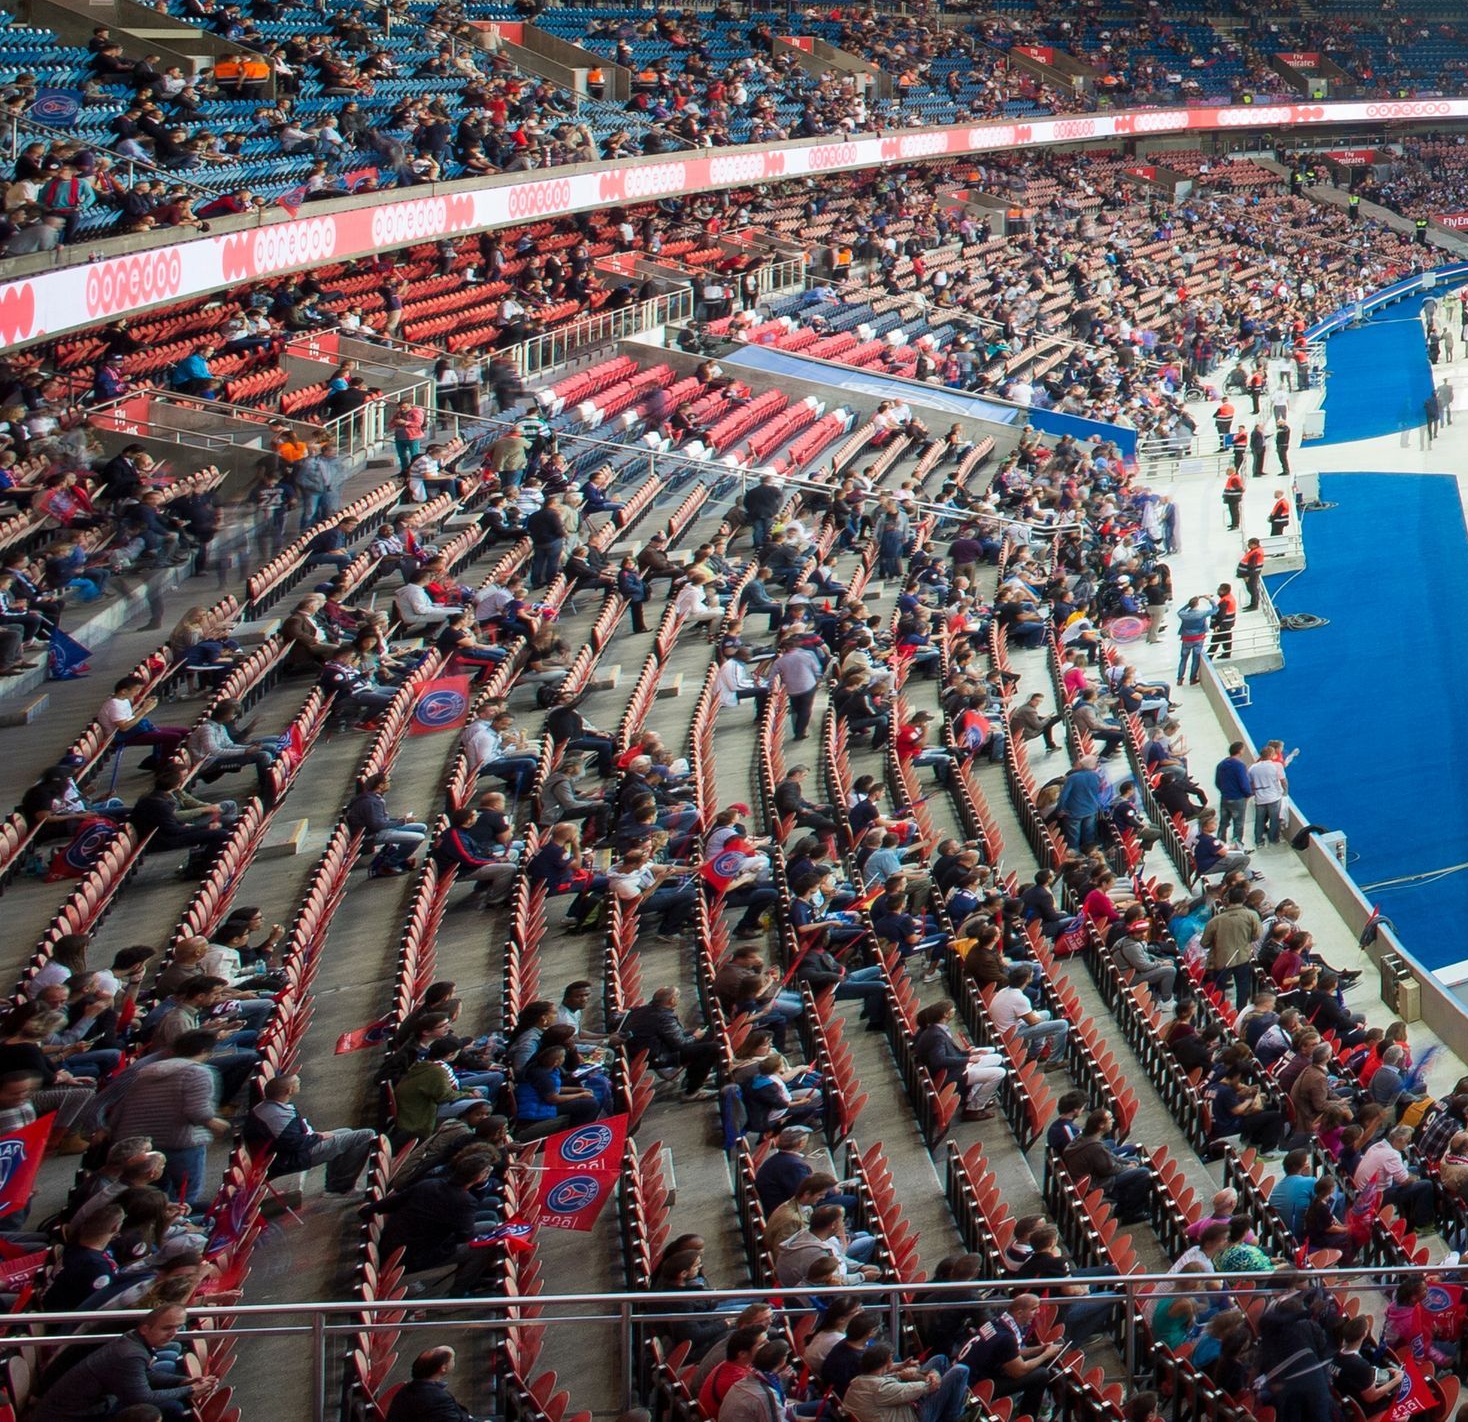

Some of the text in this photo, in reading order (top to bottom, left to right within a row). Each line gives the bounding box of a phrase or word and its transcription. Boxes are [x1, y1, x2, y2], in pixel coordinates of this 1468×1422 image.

[373, 199, 445, 244] ooredoo
[510, 182, 569, 216] ooredoo
[1443, 217, 1457, 227] Fly
[255, 219, 335, 272] ooredoo
[87, 250, 180, 314] ooredoo
